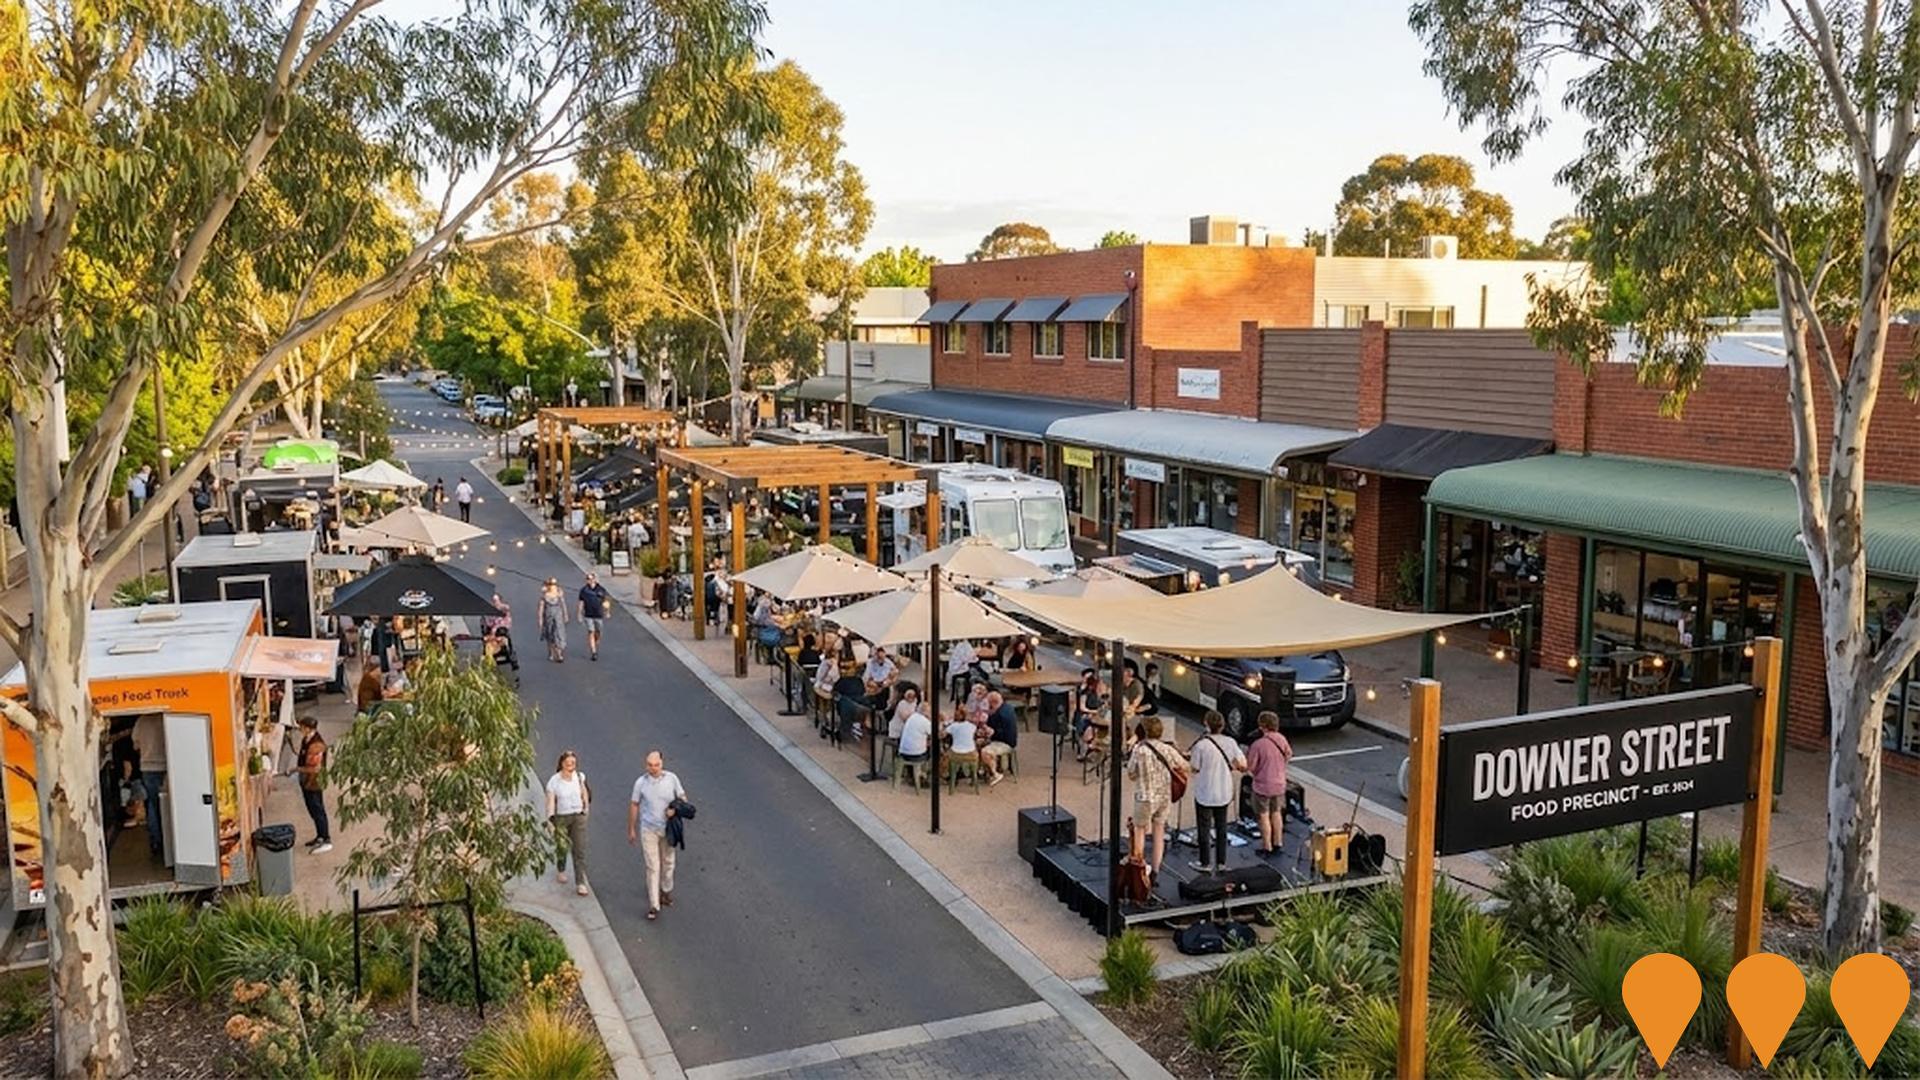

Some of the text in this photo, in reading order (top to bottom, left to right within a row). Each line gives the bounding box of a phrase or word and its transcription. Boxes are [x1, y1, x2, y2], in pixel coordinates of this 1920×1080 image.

[1473, 715, 1732, 801] DOWNER STREET
[1511, 800, 1558, 821] FOOD
[1562, 785, 1640, 812] PRECINCT
